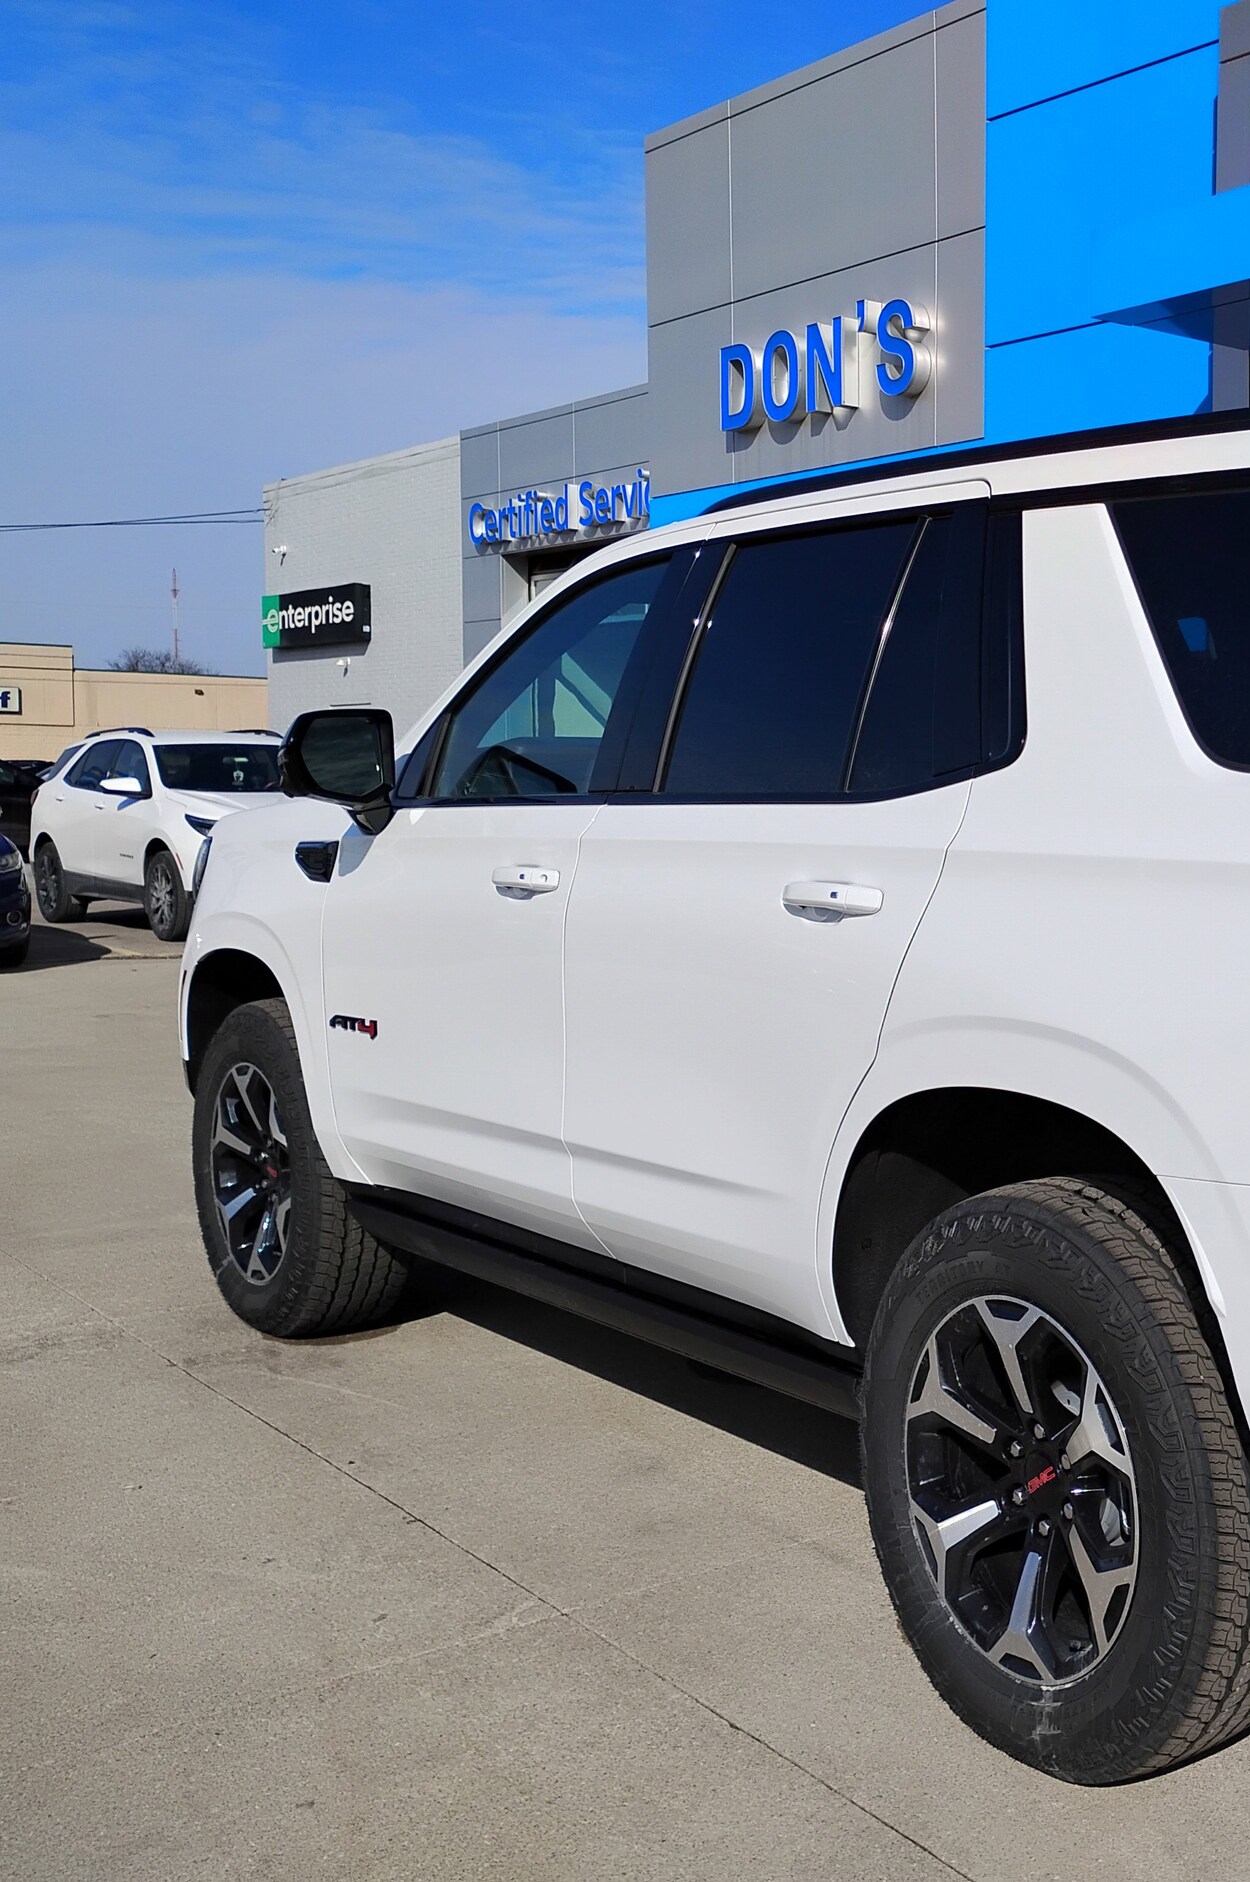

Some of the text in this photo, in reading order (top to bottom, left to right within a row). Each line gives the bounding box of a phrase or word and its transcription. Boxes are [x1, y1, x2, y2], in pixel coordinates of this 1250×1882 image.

[719, 298, 926, 431] DON'S
[468, 483, 573, 545] Certified
[262, 595, 354, 634] enterprise
[328, 1014, 378, 1041] AT4
[1027, 1466, 1056, 1494] GMC
